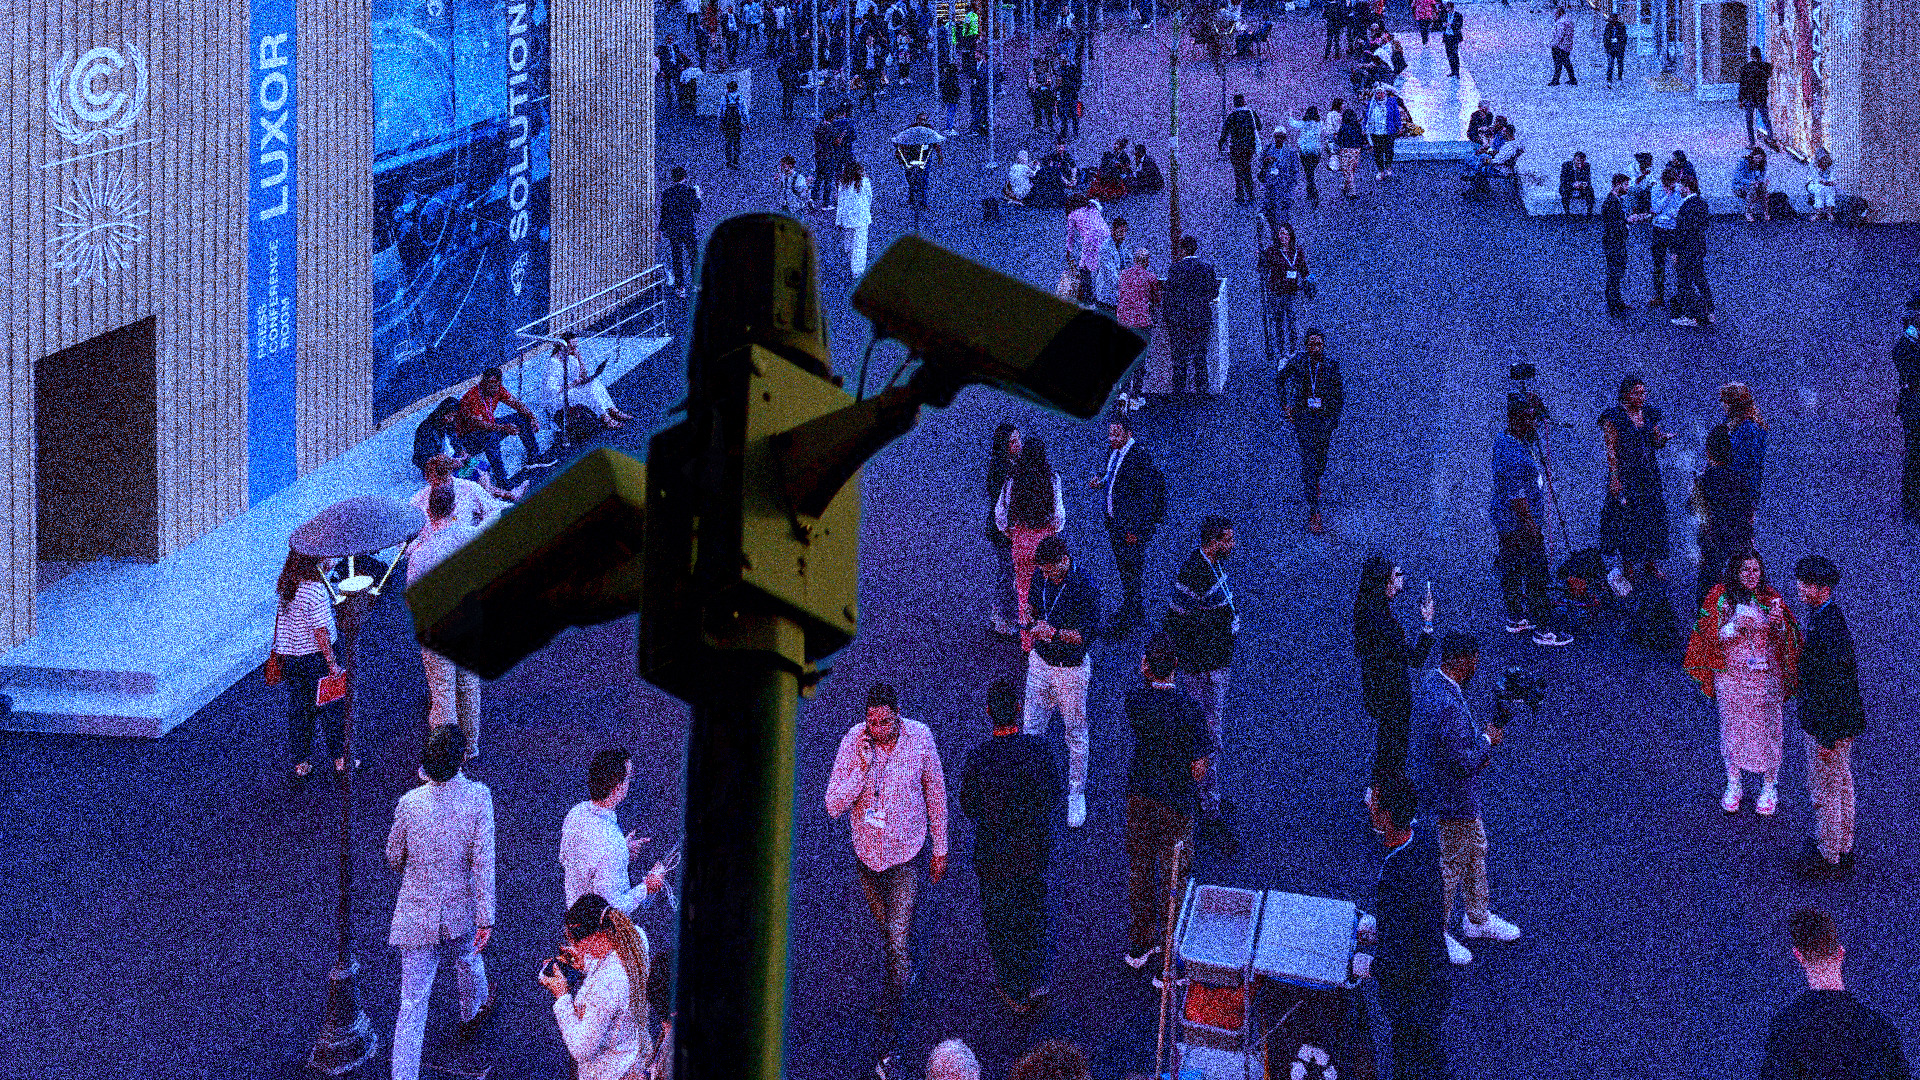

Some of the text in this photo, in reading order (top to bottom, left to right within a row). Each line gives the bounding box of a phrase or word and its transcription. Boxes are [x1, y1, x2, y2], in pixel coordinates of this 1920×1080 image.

[260, 32, 289, 221] LUXOR
[257, 304, 267, 359] PRESS
[269, 239, 279, 353] CONFERENCE
[280, 297, 290, 349] ROOM
